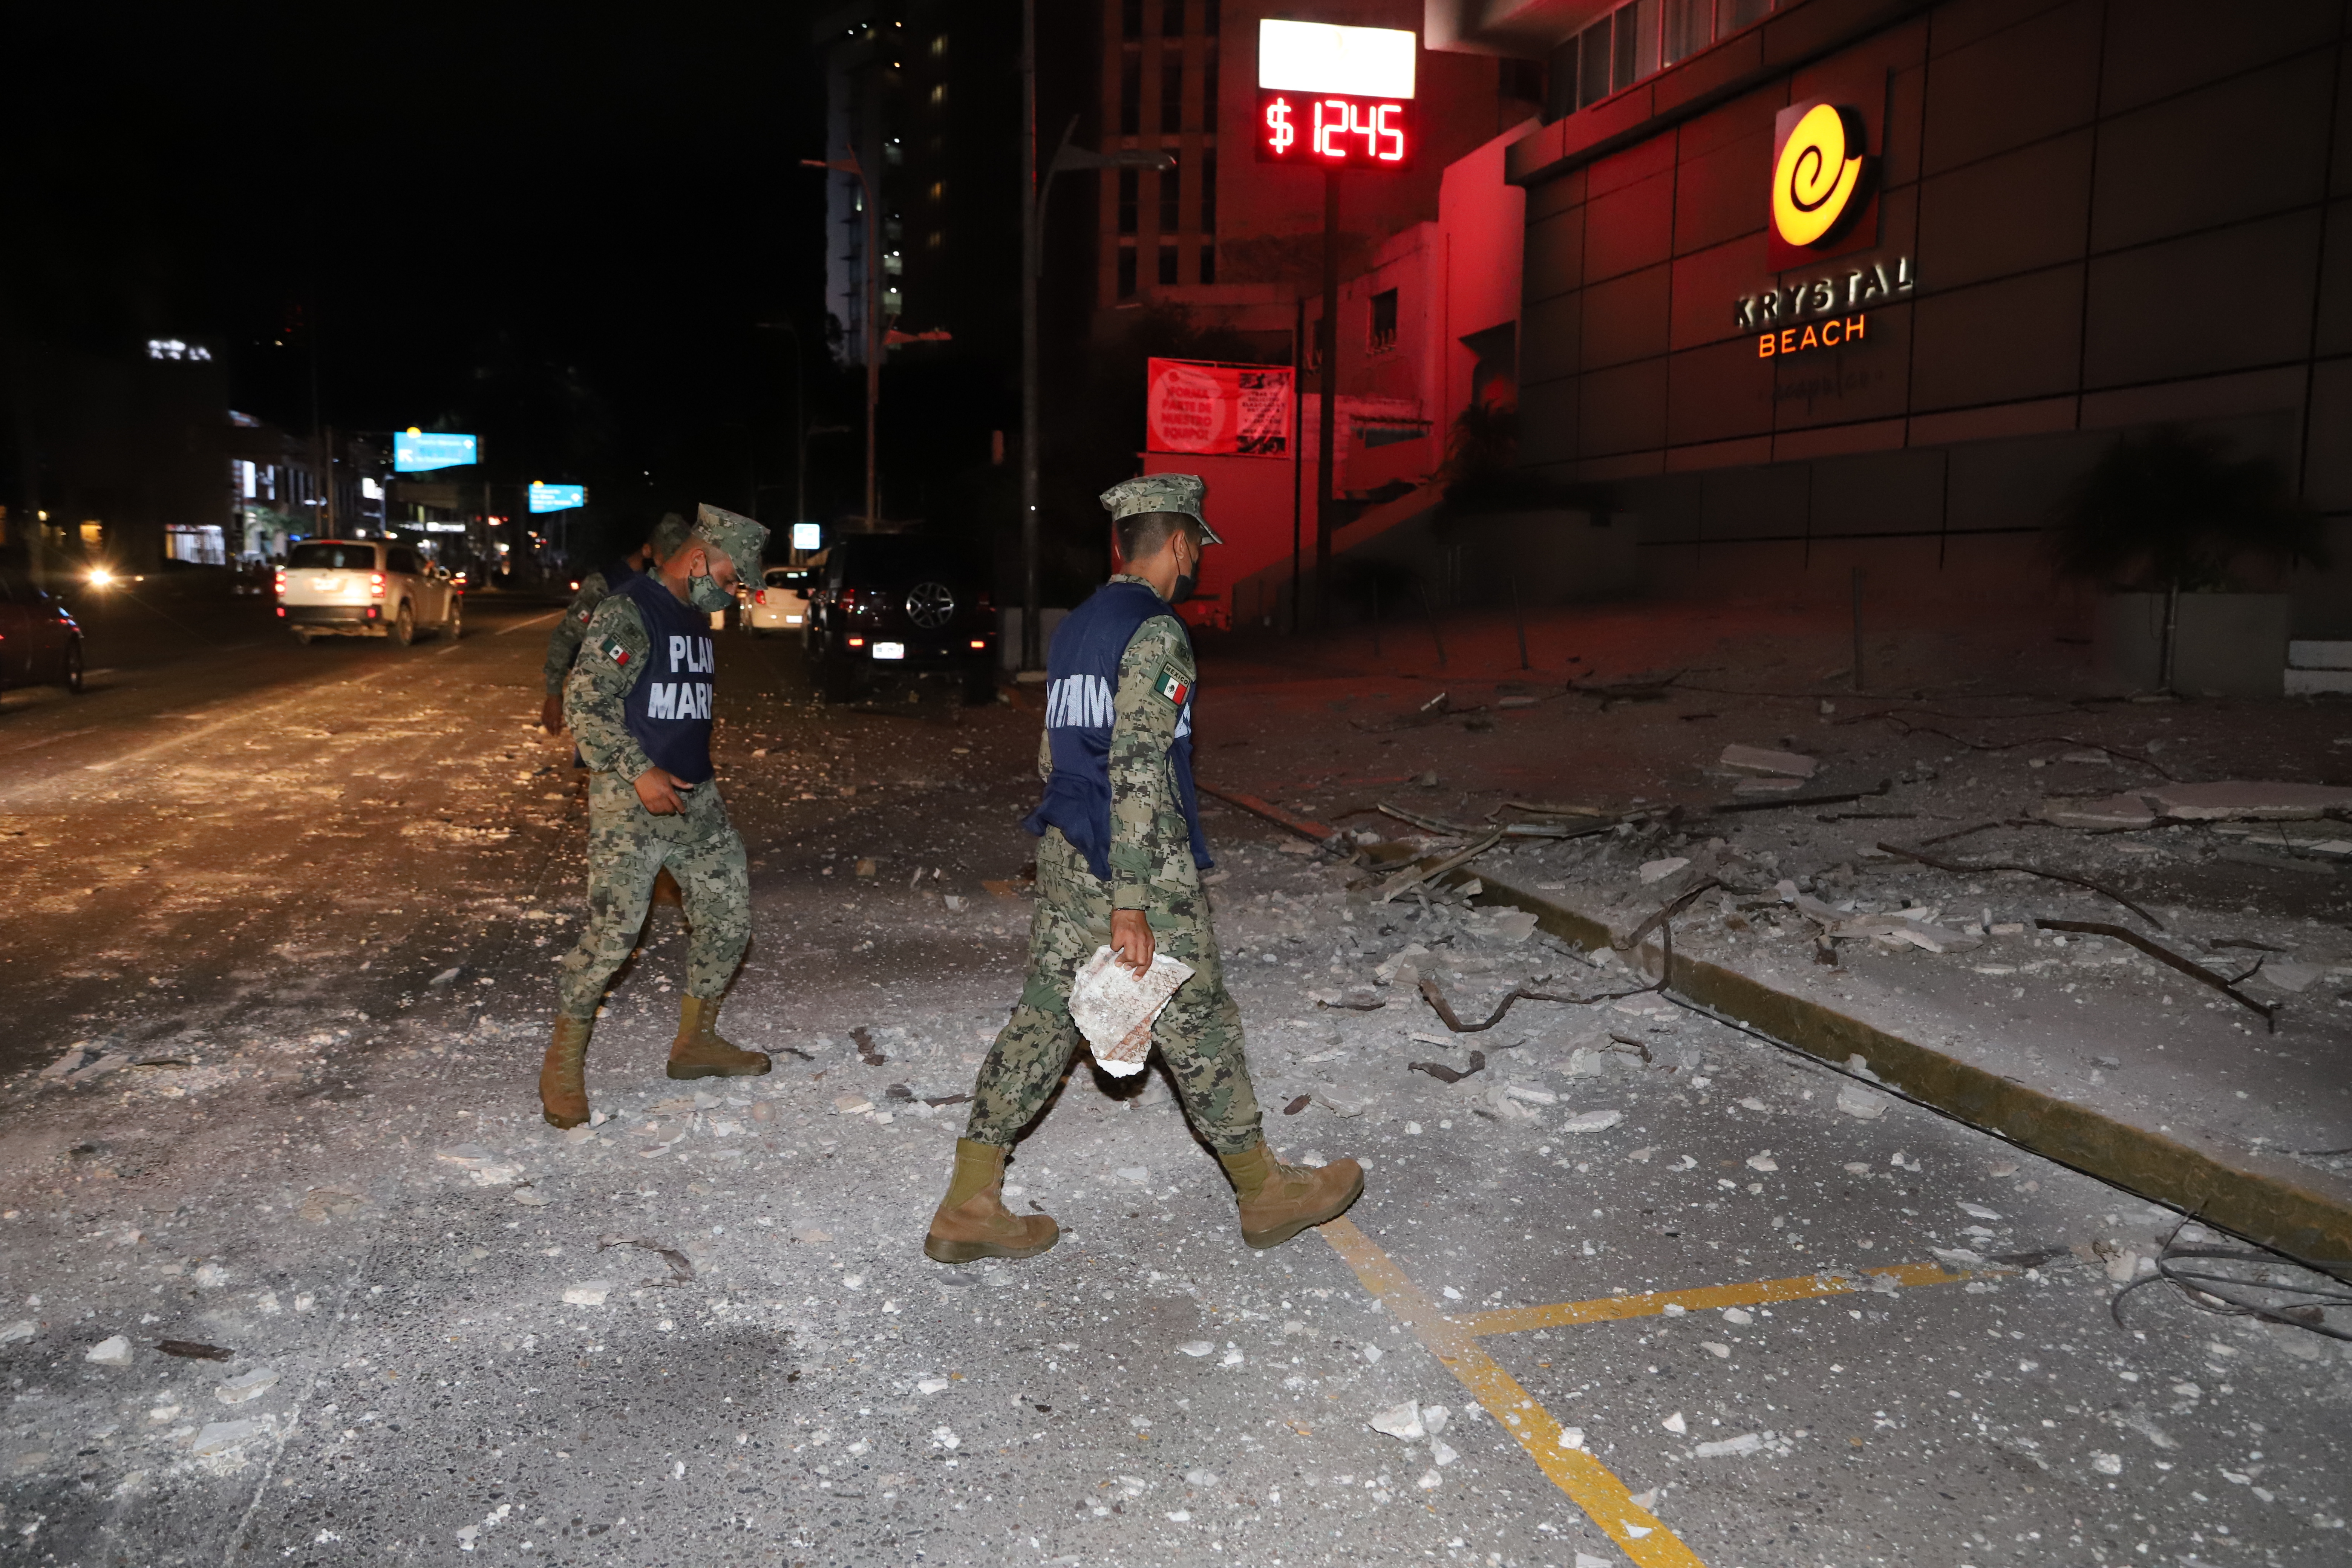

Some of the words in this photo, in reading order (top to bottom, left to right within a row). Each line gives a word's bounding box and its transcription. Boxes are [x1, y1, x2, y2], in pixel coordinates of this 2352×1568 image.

[1267, 97, 1294, 154] $
[1313, 100, 1403, 161] 1245
[1735, 256, 1913, 329] KRYSTAL
[1759, 314, 1865, 358] BEACH
[1165, 665, 1188, 685] MÉXICO
